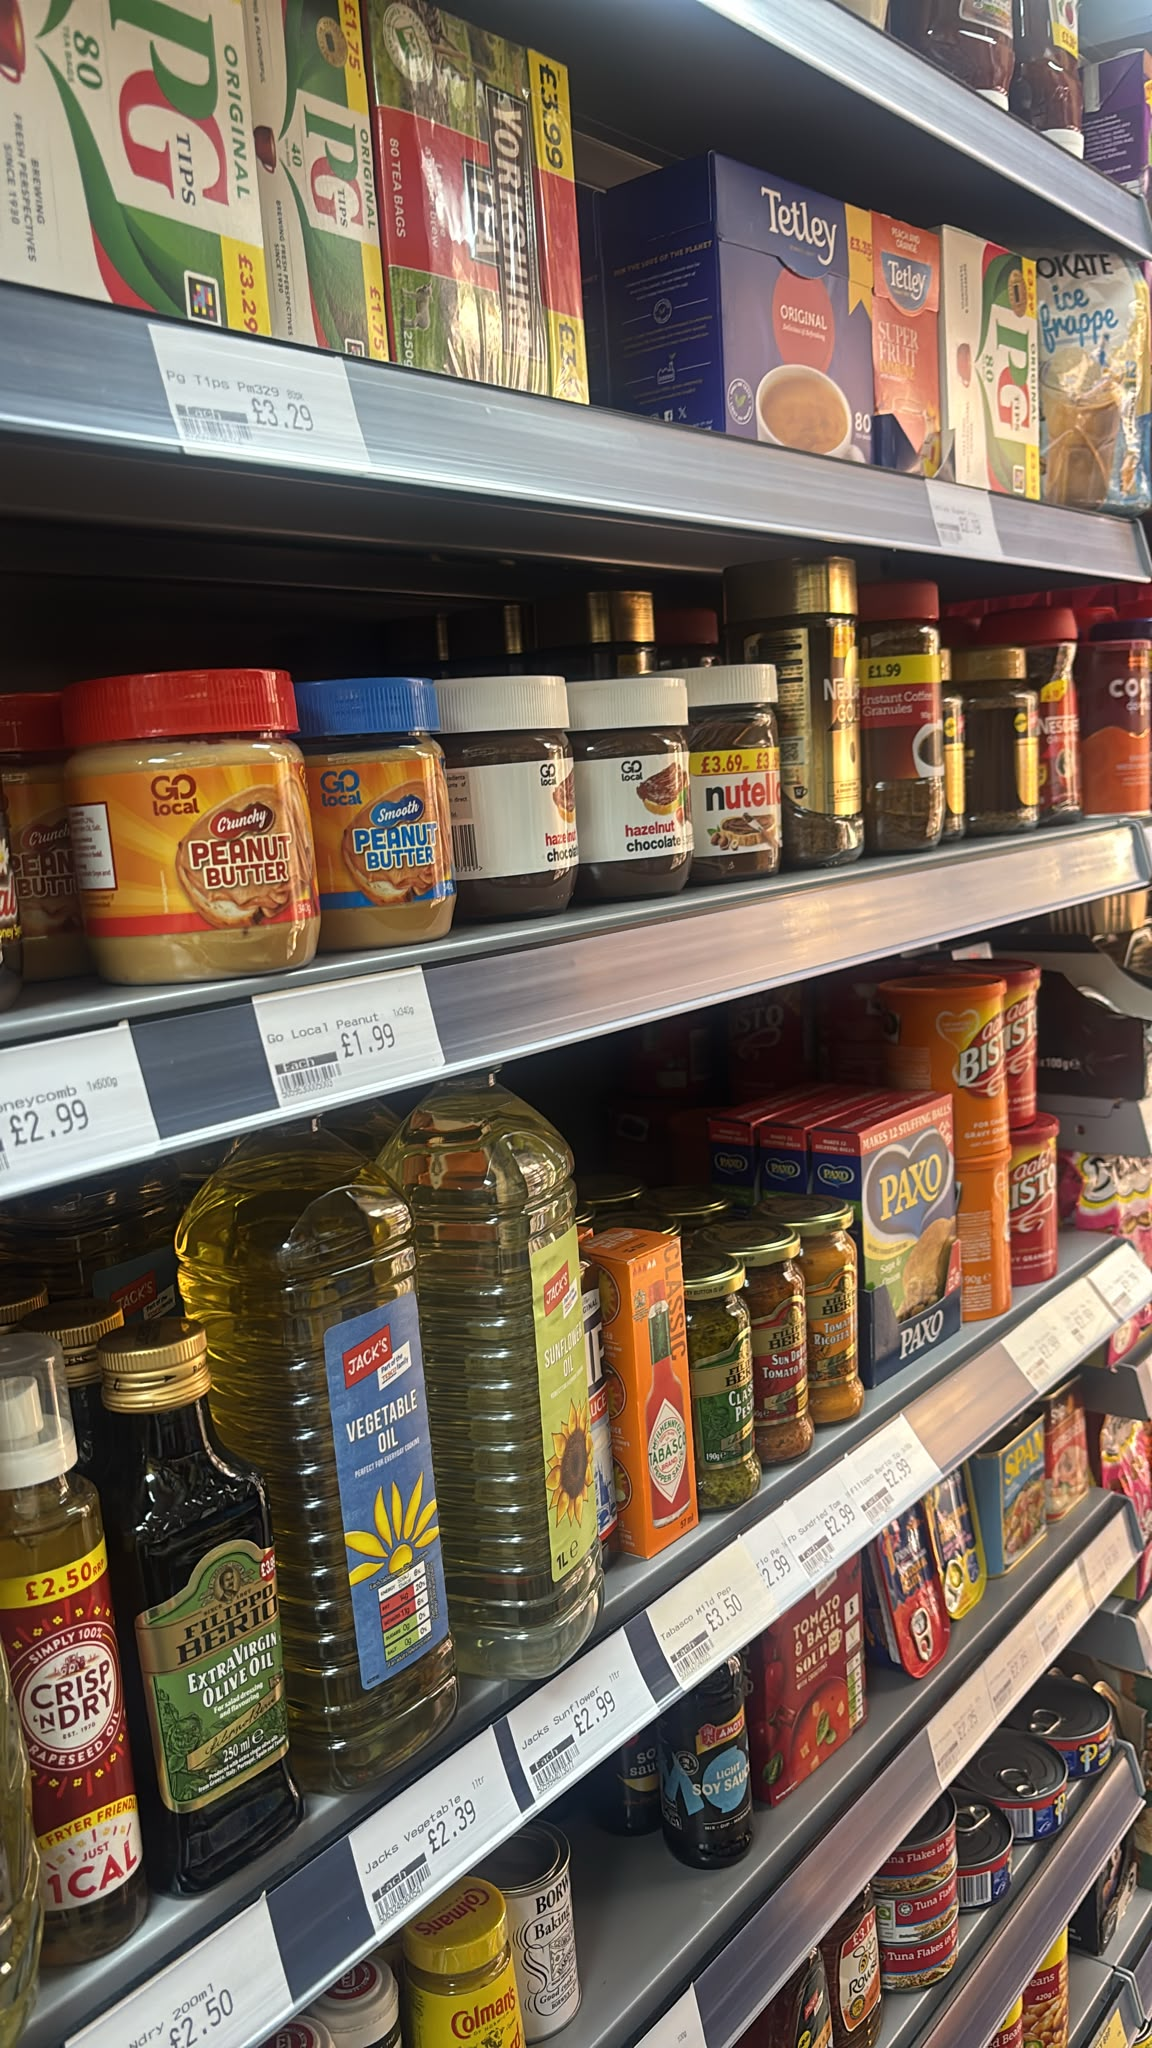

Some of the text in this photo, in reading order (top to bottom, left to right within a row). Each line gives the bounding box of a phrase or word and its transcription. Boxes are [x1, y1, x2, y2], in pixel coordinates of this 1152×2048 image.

[344, 0, 361, 72] £1.75
[73, 29, 103, 90] 80
[224, 44, 250, 199] ORIGINAL
[539, 62, 562, 170] £3.99
[176, 133, 196, 206] TIPS
[291, 143, 302, 168] 40
[304, 104, 364, 226] PG
[3, 142, 20, 225] SINCE 1930
[13, 112, 37, 263] FRESH PERSPECTIVES
[31, 157, 45, 225] BREWING
[360, 128, 376, 230] ORIGINAL
[389, 137, 406, 238] 80 TEA BAGS
[337, 188, 349, 229] TIPS
[761, 186, 838, 266] Tetley
[238, 253, 259, 334] £3.29
[888, 260, 925, 301] Tetley
[1053, 285, 1090, 311] ice
[780, 305, 828, 331] ORIGINAL
[878, 320, 919, 349] SUPER
[1039, 306, 1119, 353] frappe
[879, 340, 918, 367] FRUIT
[165, 370, 186, 385] Pg
[237, 382, 281, 398] Pm329
[996, 319, 1030, 429] PG
[251, 397, 315, 432] £3.29
[855, 413, 871, 433] 80
[868, 664, 902, 680] £1.99
[861, 690, 933, 706] Instant Coffee
[862, 704, 913, 717] Granules
[540, 764, 556, 777] GO
[621, 760, 642, 773] GO
[622, 770, 643, 782] local
[701, 754, 743, 774] £3.69
[151, 774, 197, 801] GO
[320, 770, 360, 794] GO
[541, 778, 557, 787] local
[153, 798, 200, 817] local
[322, 791, 363, 808] local
[377, 799, 420, 824] Smooth
[216, 808, 268, 834] Crunchy
[625, 821, 675, 838] hazelnut
[188, 833, 292, 870] PEANUT
[353, 822, 438, 855] PEANUT
[626, 835, 681, 852] chocolate
[205, 861, 289, 890] BUTTER
[365, 848, 436, 872] BUTTER
[267, 1005, 415, 1045] Go Local Peanut 1x340g
[341, 1022, 396, 1059] £1.99
[86, 1077, 118, 1093] 1x600g
[10, 1099, 89, 1148] £2.99
[863, 1132, 889, 1151] MAKES
[889, 1129, 899, 1142] 12
[898, 1114, 931, 1137] STUFFING
[932, 1103, 952, 1122] BALLS
[823, 1168, 849, 1181] PAXO
[879, 1153, 942, 1222] PAXO
[880, 1260, 896, 1275] Sage
[546, 1272, 568, 1305] JACK'S
[662, 1242, 687, 1362] CLASSIC
[544, 1320, 583, 1369] SUNFLOWER
[814, 1328, 850, 1346] RICOTTA
[900, 1310, 944, 1359] PAXO
[347, 1338, 390, 1376] JACK'S
[381, 1363, 391, 1374] Part
[563, 1354, 574, 1378] OIL
[762, 1365, 800, 1380] TOMATO
[772, 1353, 790, 1366] SUN
[345, 1388, 418, 1443] VEGETABLE
[377, 1427, 399, 1453] OIL
[706, 1452, 720, 1461] 190g
[354, 1437, 420, 1479] PERFECT FOR EVERYDAY COOKING
[653, 1465, 672, 1483] PEPPER
[661, 1456, 678, 1471] BRAND
[883, 1458, 912, 1489] £2.99
[824, 1503, 856, 1538] £2.99
[556, 1554, 569, 1571] 1L
[26, 1560, 104, 1601] £2.50 RRP
[183, 1583, 274, 1641] FILIPPO
[203, 1604, 223, 1616] SINCE
[660, 1585, 733, 1642] Tabasco Pep
[705, 1594, 744, 1633] £3.50
[793, 1594, 841, 1640] TOMATO
[28, 1626, 104, 1665] SIMPLY 100%
[176, 1594, 278, 1665] BERIO
[795, 1610, 842, 1657] & BASIL
[187, 1631, 277, 1694] EXTRA VIRGIN
[795, 1642, 828, 1678] SOUP
[31, 1659, 112, 1710] CRISP
[202, 1652, 274, 1708] OLIVE OIL
[58, 1680, 113, 1731] DRY
[213, 1682, 264, 1714] For salad dressing
[219, 1692, 260, 1719] and flavouring
[573, 1689, 617, 1738] £2.99
[106, 1709, 121, 1737] OIL
[522, 1684, 601, 1751] Jacks Sunflower
[62, 1730, 79, 1740] EST.
[223, 1736, 251, 1763] 250 ml
[208, 1766, 228, 1780] Produced
[716, 1761, 741, 1780] LIGHT
[692, 1781, 720, 1797] SOY
[46, 1817, 93, 1845] FRYER
[365, 1793, 462, 1875] Jacks Vegetable
[427, 1799, 478, 1856] £2.39
[81, 1841, 110, 1863] JUST
[907, 1847, 936, 1864] Flakes
[47, 1845, 137, 1905] 1CAL
[414, 1886, 491, 1937] Colman's
[914, 1897, 938, 1911] Tuna
[534, 1904, 571, 1941] Baking
[887, 1940, 944, 1961] Tuna Flakes
[169, 1988, 235, 2048] £2.50
[451, 1986, 516, 2040] Colman's
